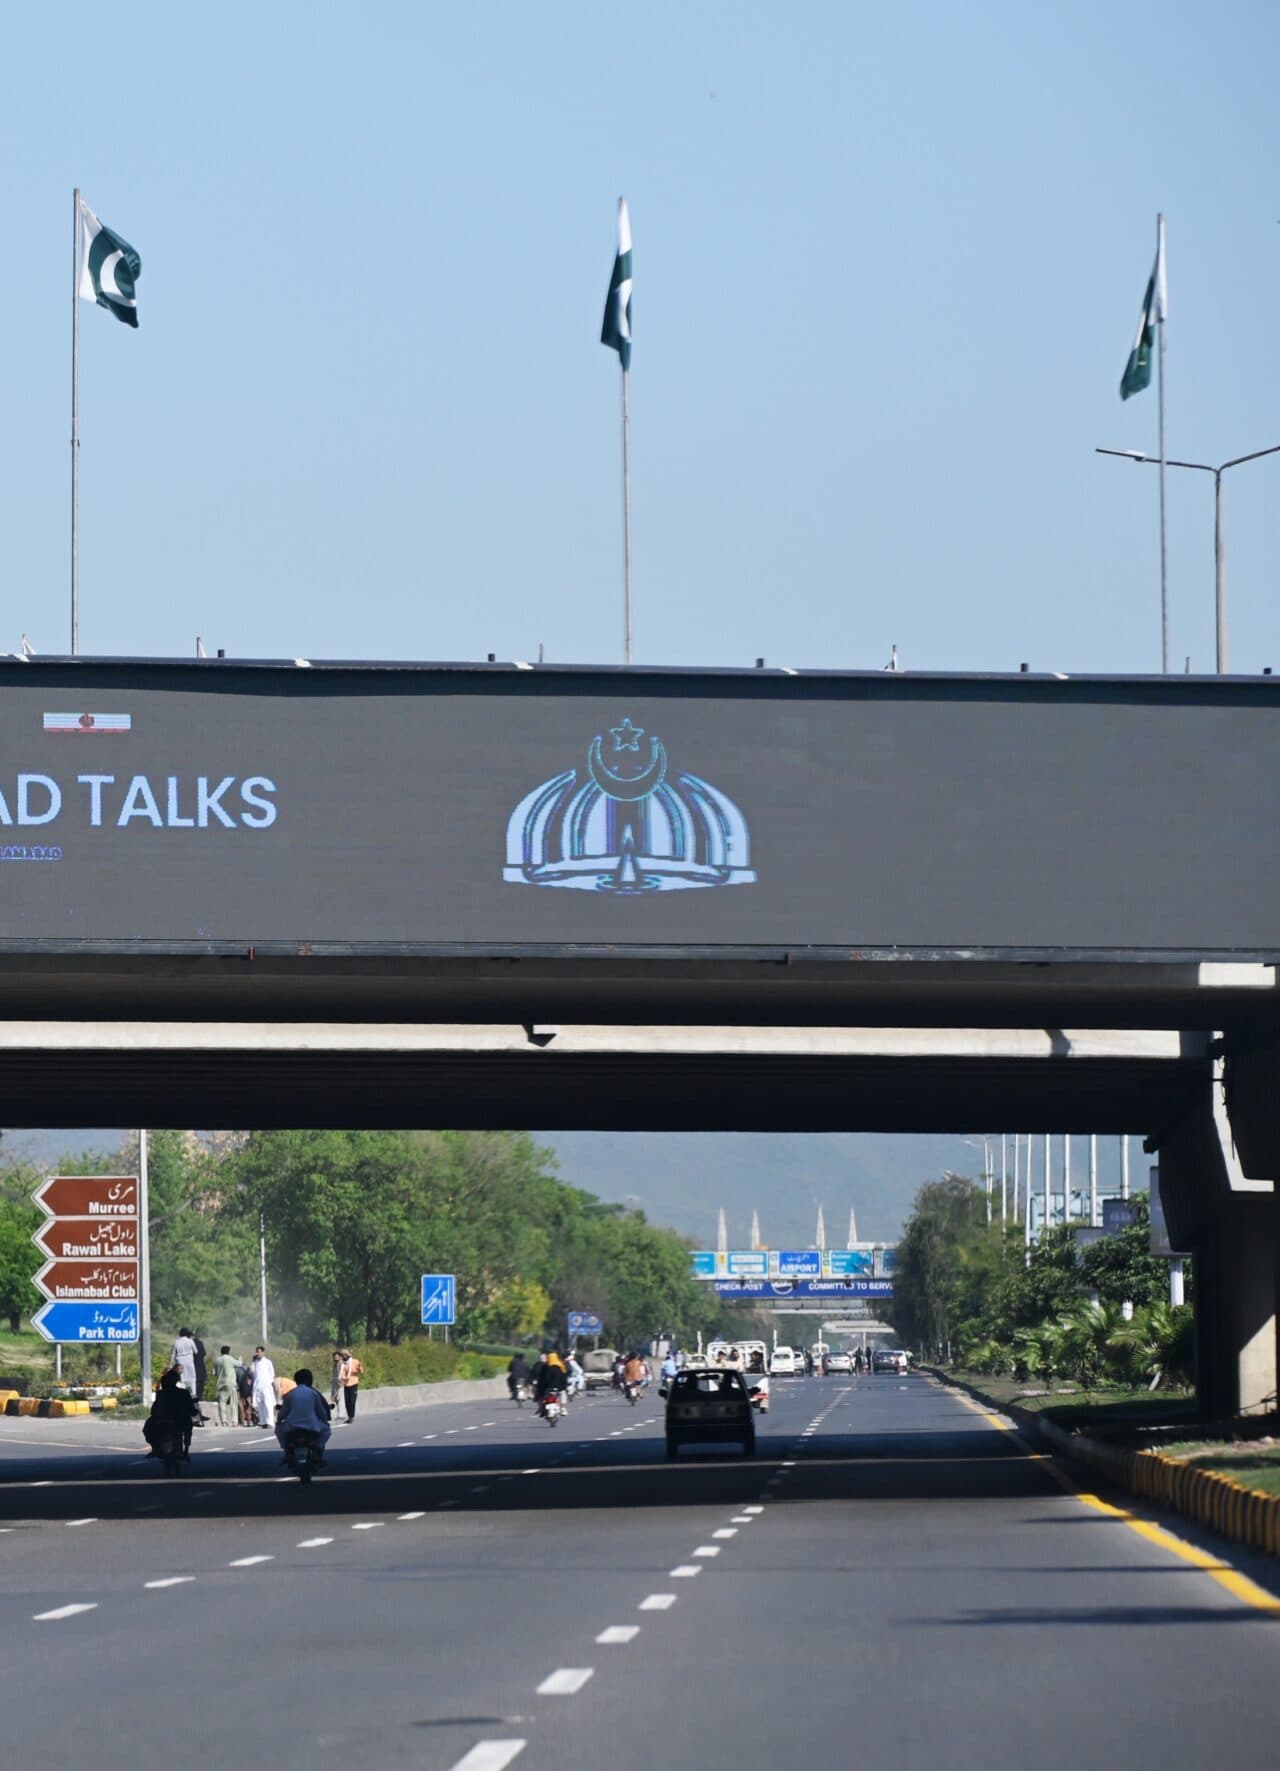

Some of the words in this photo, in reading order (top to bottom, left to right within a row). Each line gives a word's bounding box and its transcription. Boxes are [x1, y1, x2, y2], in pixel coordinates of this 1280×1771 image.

[77, 774, 279, 830] TALKS
[108, 1183, 134, 1200] مری
[88, 1202, 136, 1214] Murree
[109, 1224, 135, 1242] راول
[62, 1243, 101, 1256] Rawal
[104, 1243, 136, 1256] Lake
[780, 1263, 817, 1273] AIRPORT
[56, 1285, 110, 1298] Islamabad
[112, 1285, 136, 1298] Club
[857, 1282, 868, 1291] TO
[110, 1306, 136, 1326] پارک
[79, 1327, 106, 1339] Park
[108, 1327, 136, 1339] Road
